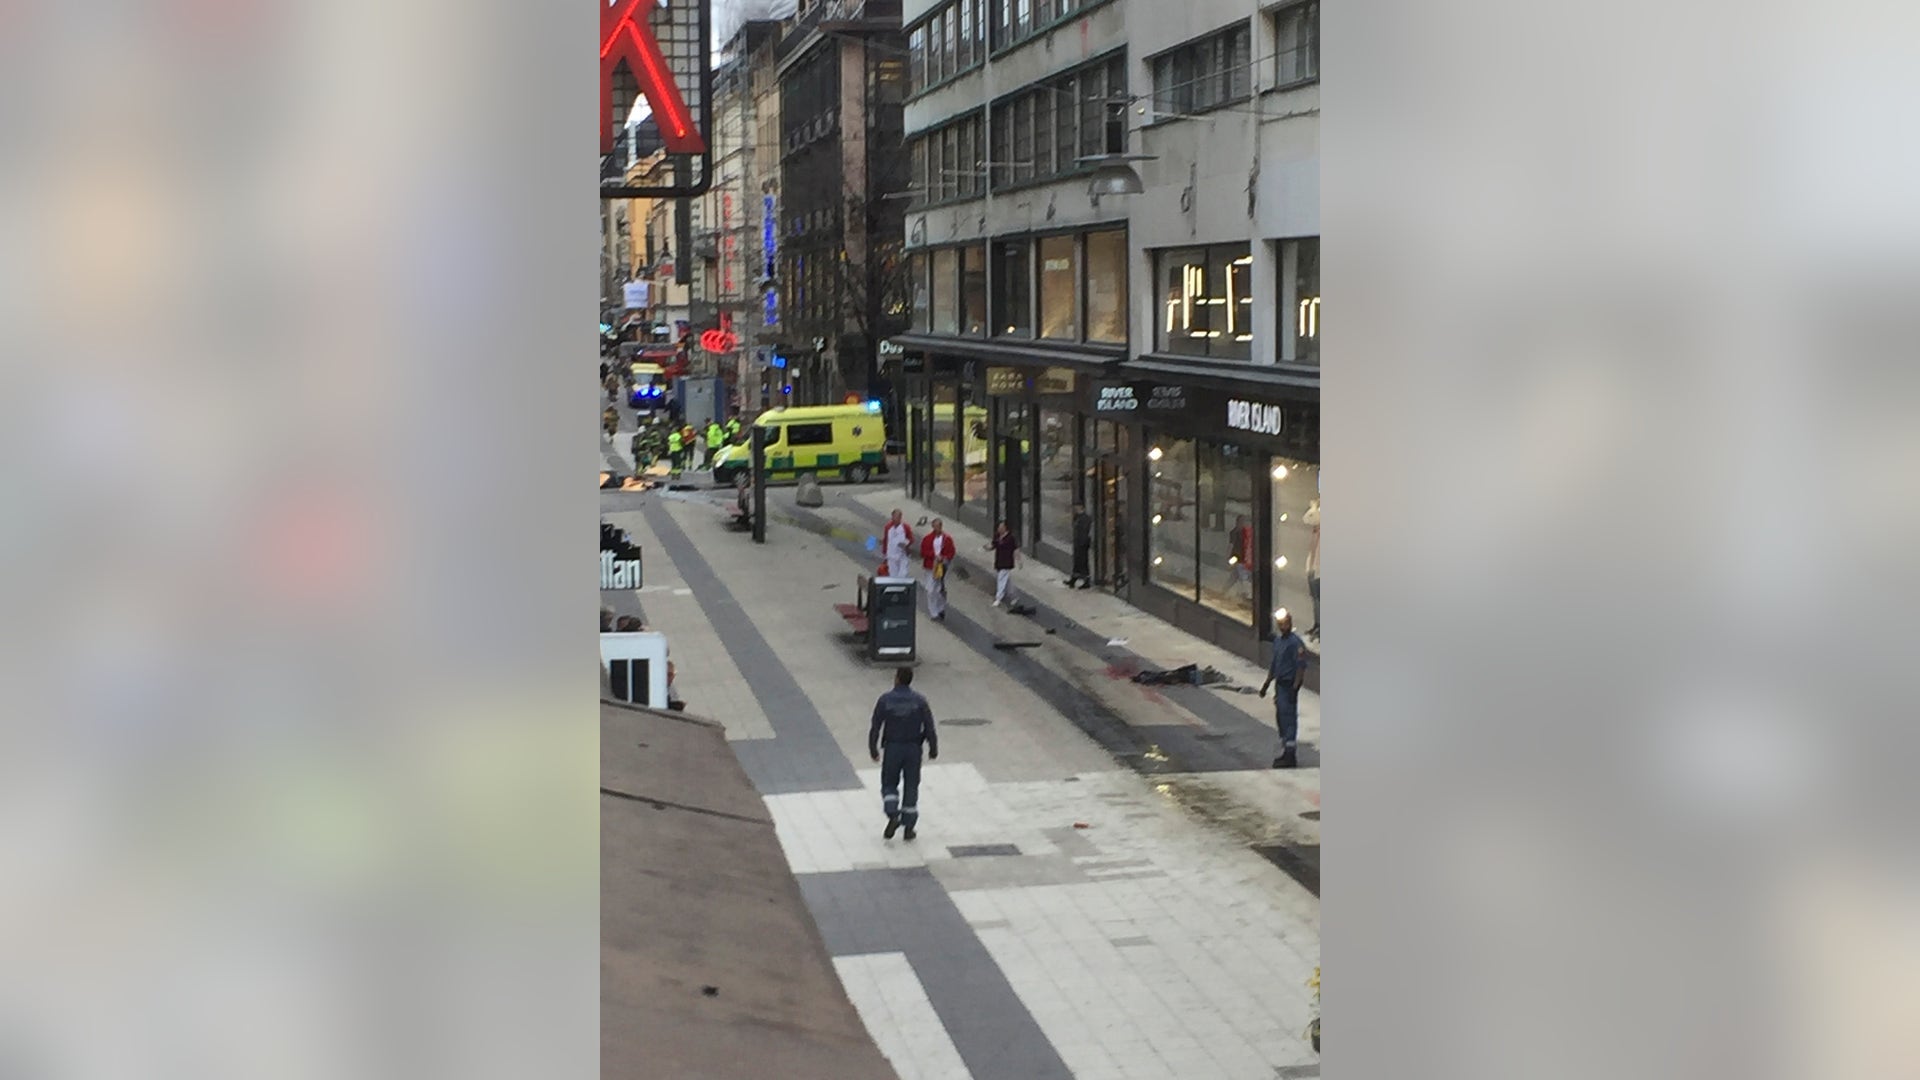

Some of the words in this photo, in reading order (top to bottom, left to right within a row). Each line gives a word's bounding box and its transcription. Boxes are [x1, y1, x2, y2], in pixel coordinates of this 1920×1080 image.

[1101, 386, 1135, 399] RIVER
[1097, 398, 1139, 411] ISLAND
[1227, 399, 1250, 430] RIVER
[1250, 402, 1282, 436] ISLAND
